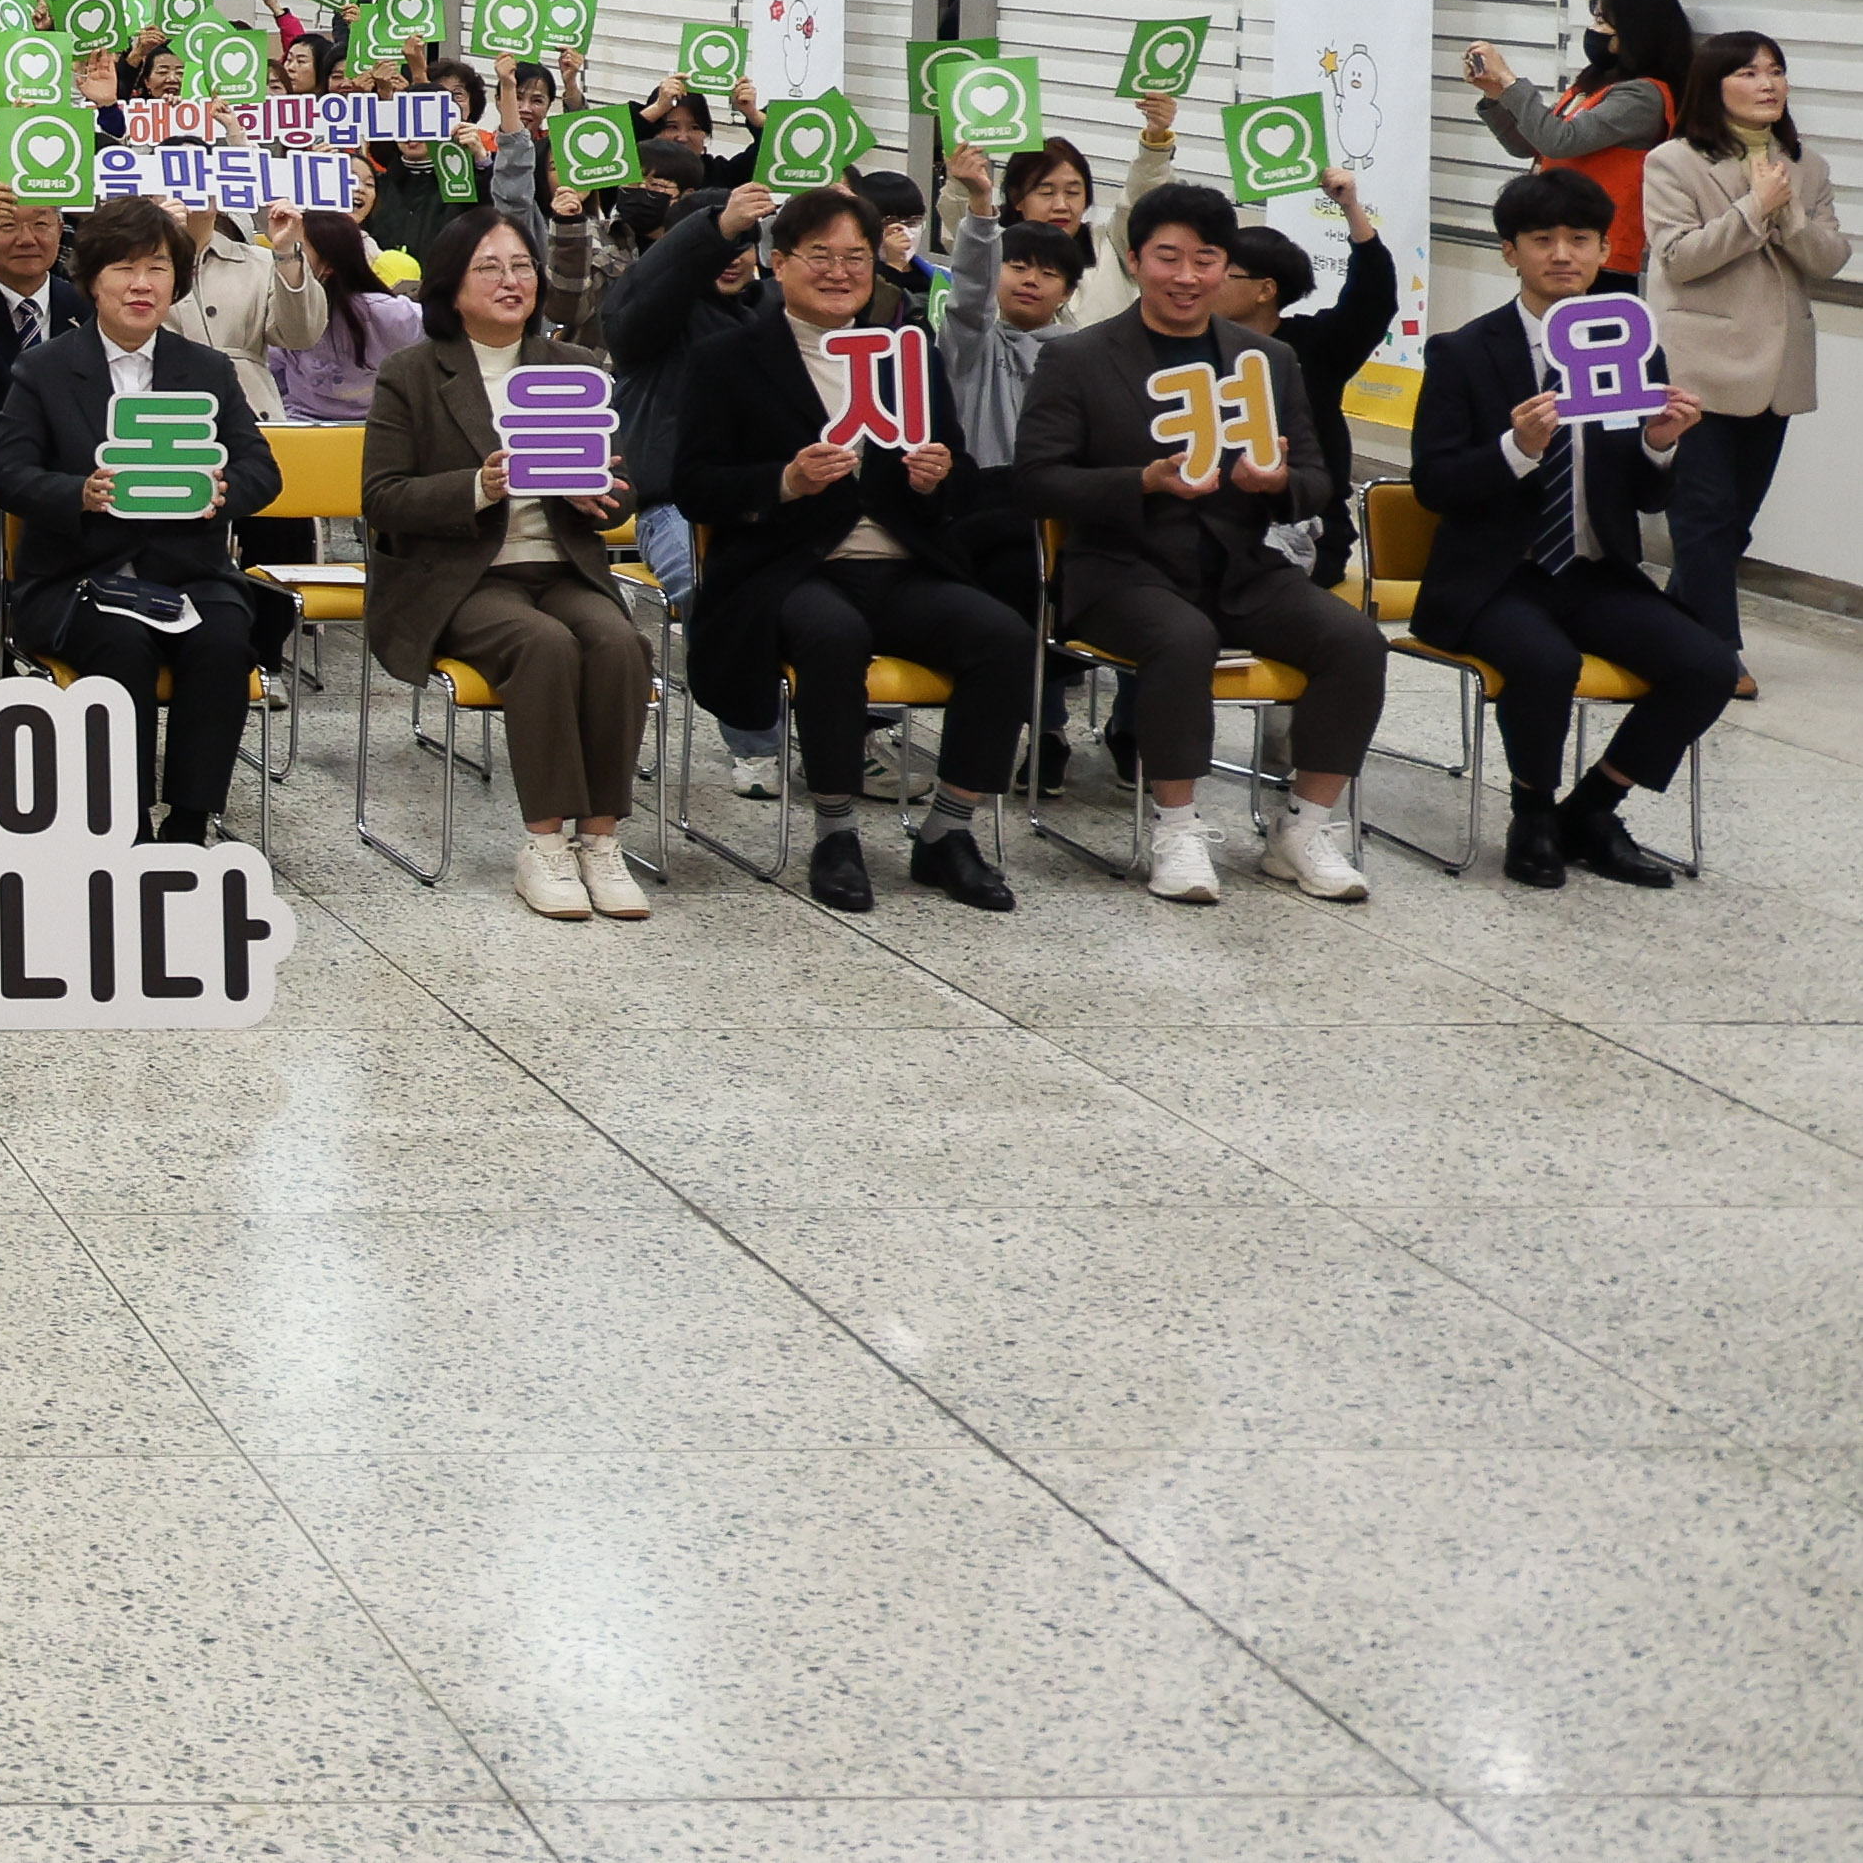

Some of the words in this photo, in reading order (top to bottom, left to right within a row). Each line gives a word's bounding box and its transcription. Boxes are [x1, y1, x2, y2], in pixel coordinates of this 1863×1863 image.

[161, 148, 357, 210] 만듭니다
[822, 328, 930, 449] 지
[1150, 349, 1287, 486] 켜
[1541, 296, 1671, 421] 요
[98, 395, 225, 518] 동
[497, 369, 618, 494] 을
